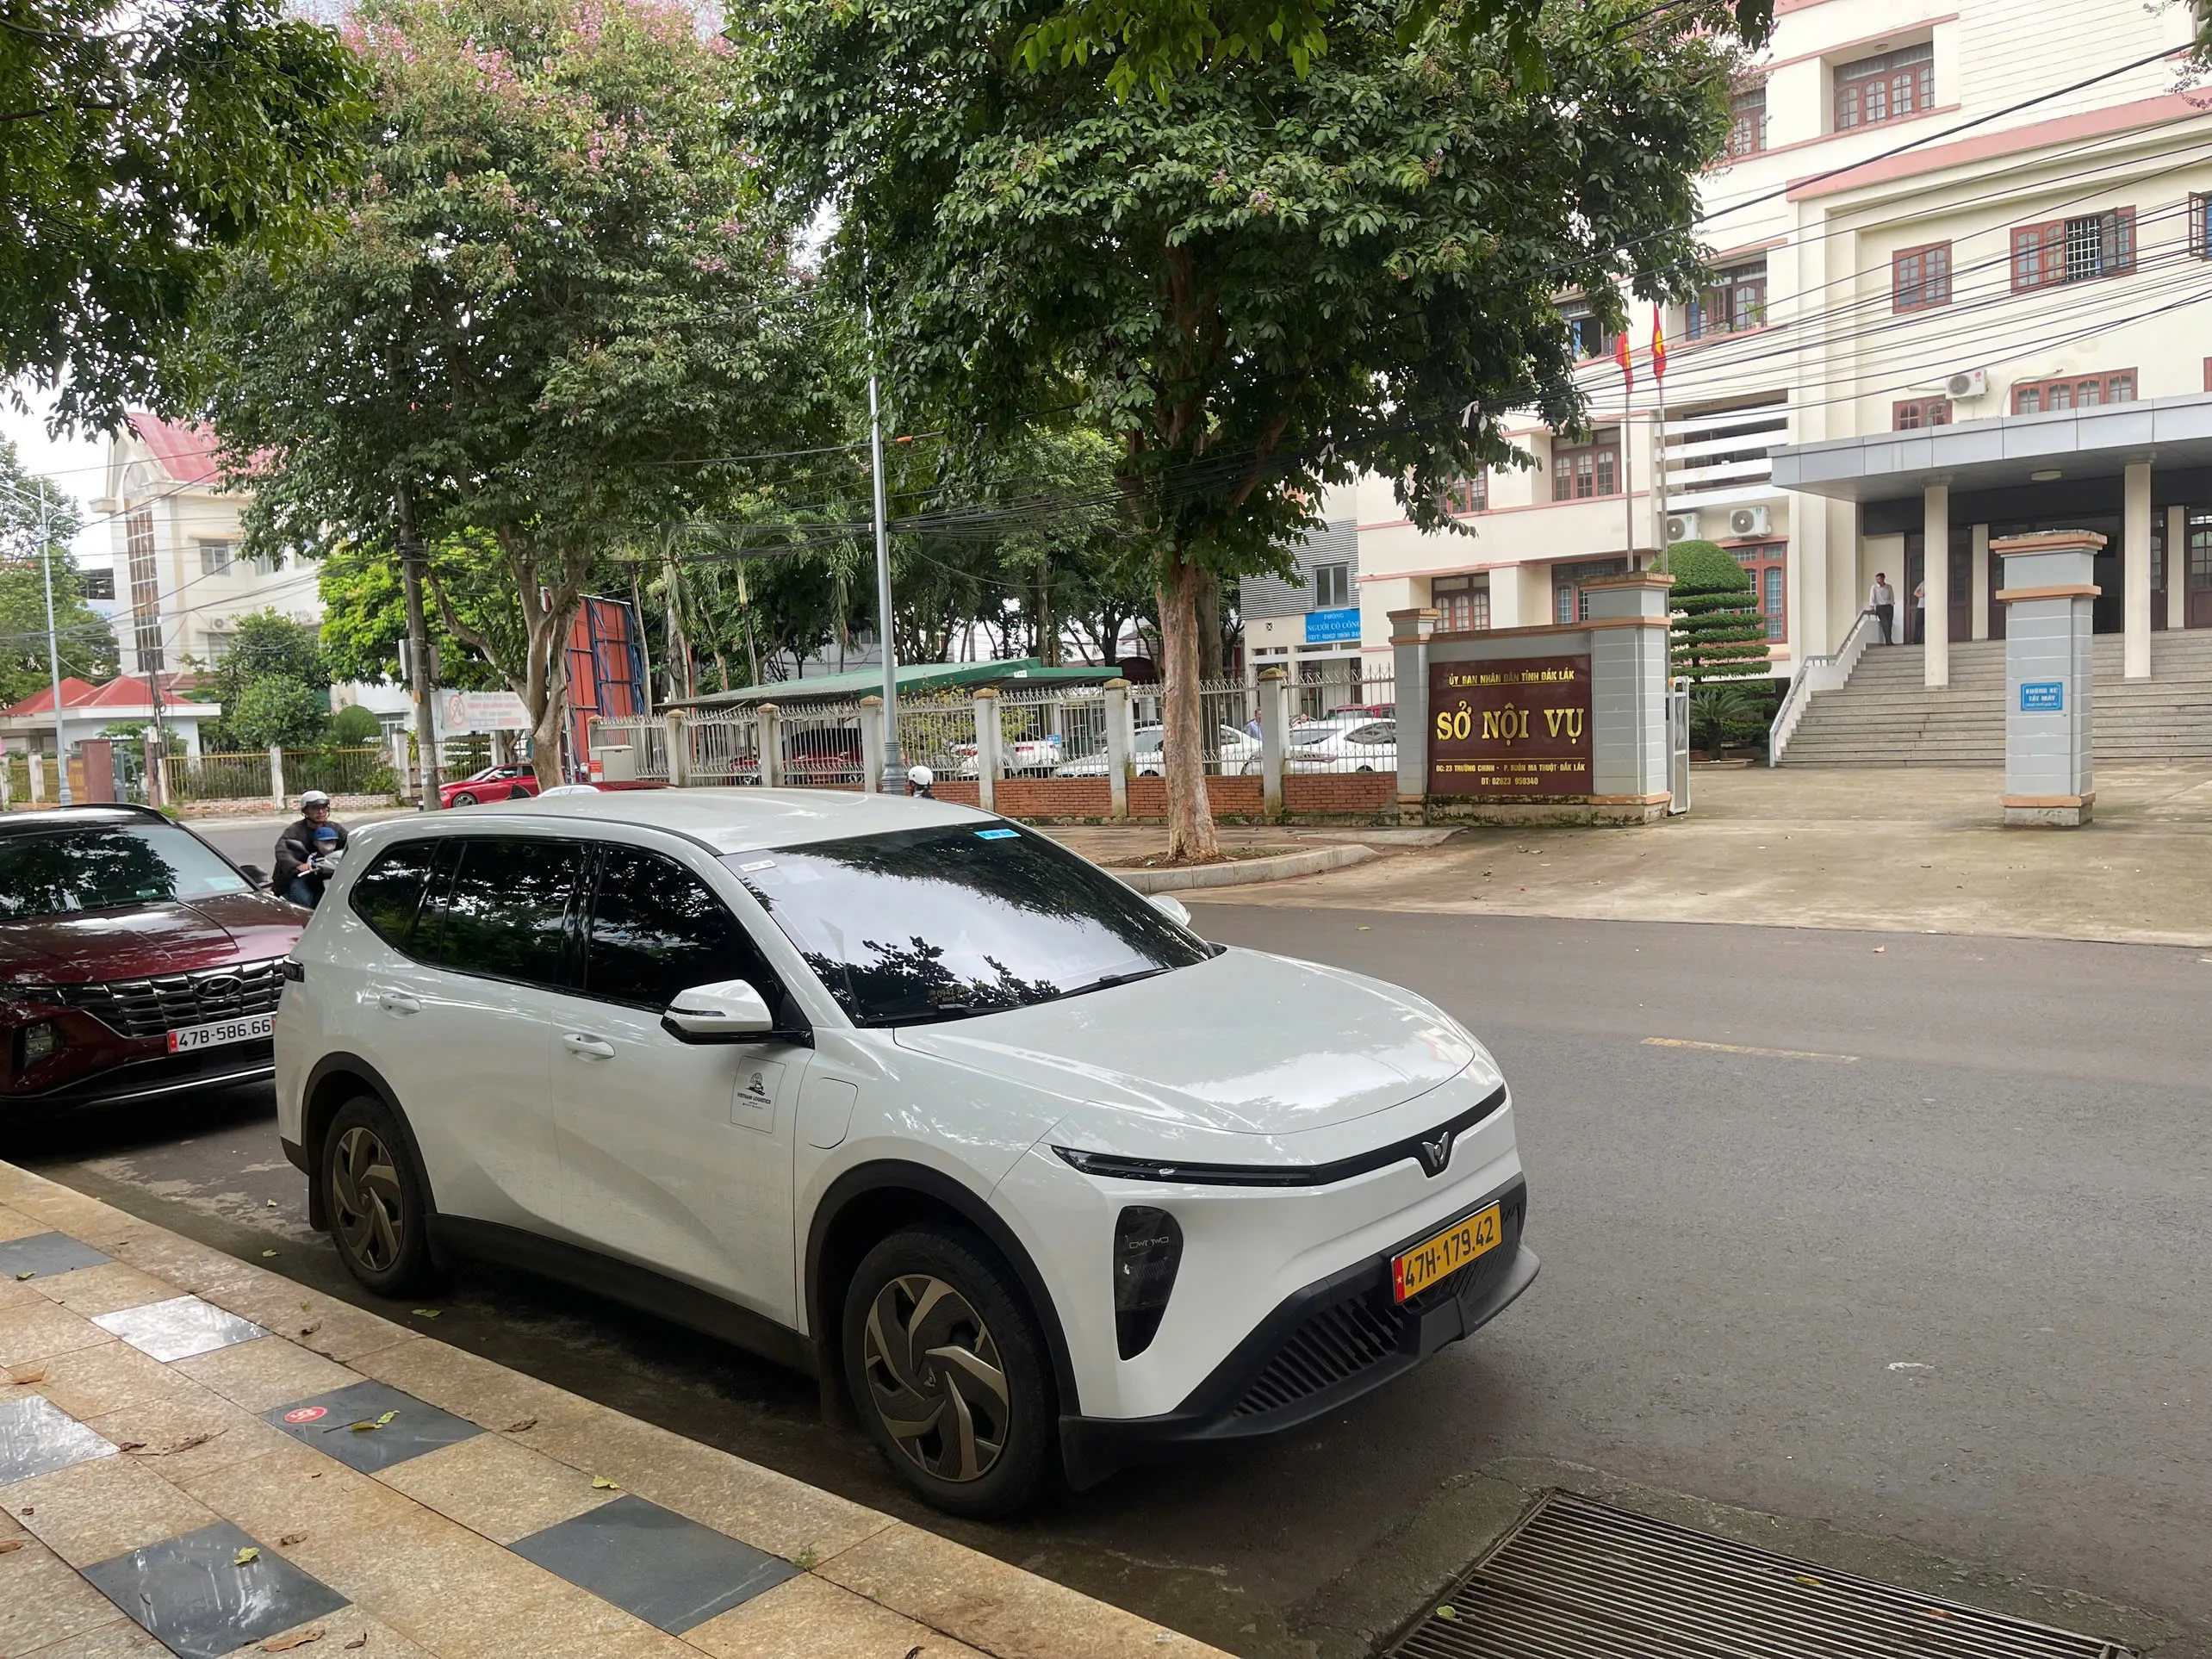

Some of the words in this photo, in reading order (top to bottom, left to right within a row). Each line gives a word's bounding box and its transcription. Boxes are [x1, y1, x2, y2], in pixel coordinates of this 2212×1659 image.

[1449, 673, 1459, 686] ỦY
[1462, 674, 1477, 685] BAN
[1480, 672, 1501, 684] NHÂN
[1503, 672, 1519, 683] DÂN
[1521, 669, 1539, 681] TỈNH
[1437, 700, 1472, 741] SỞ
[1482, 702, 1530, 747] NỘI
[1544, 708, 1585, 745] VỤ
[179, 1019, 271, 1047] 47B-586.66
[1405, 1215, 1494, 1287] 47H-179.42
